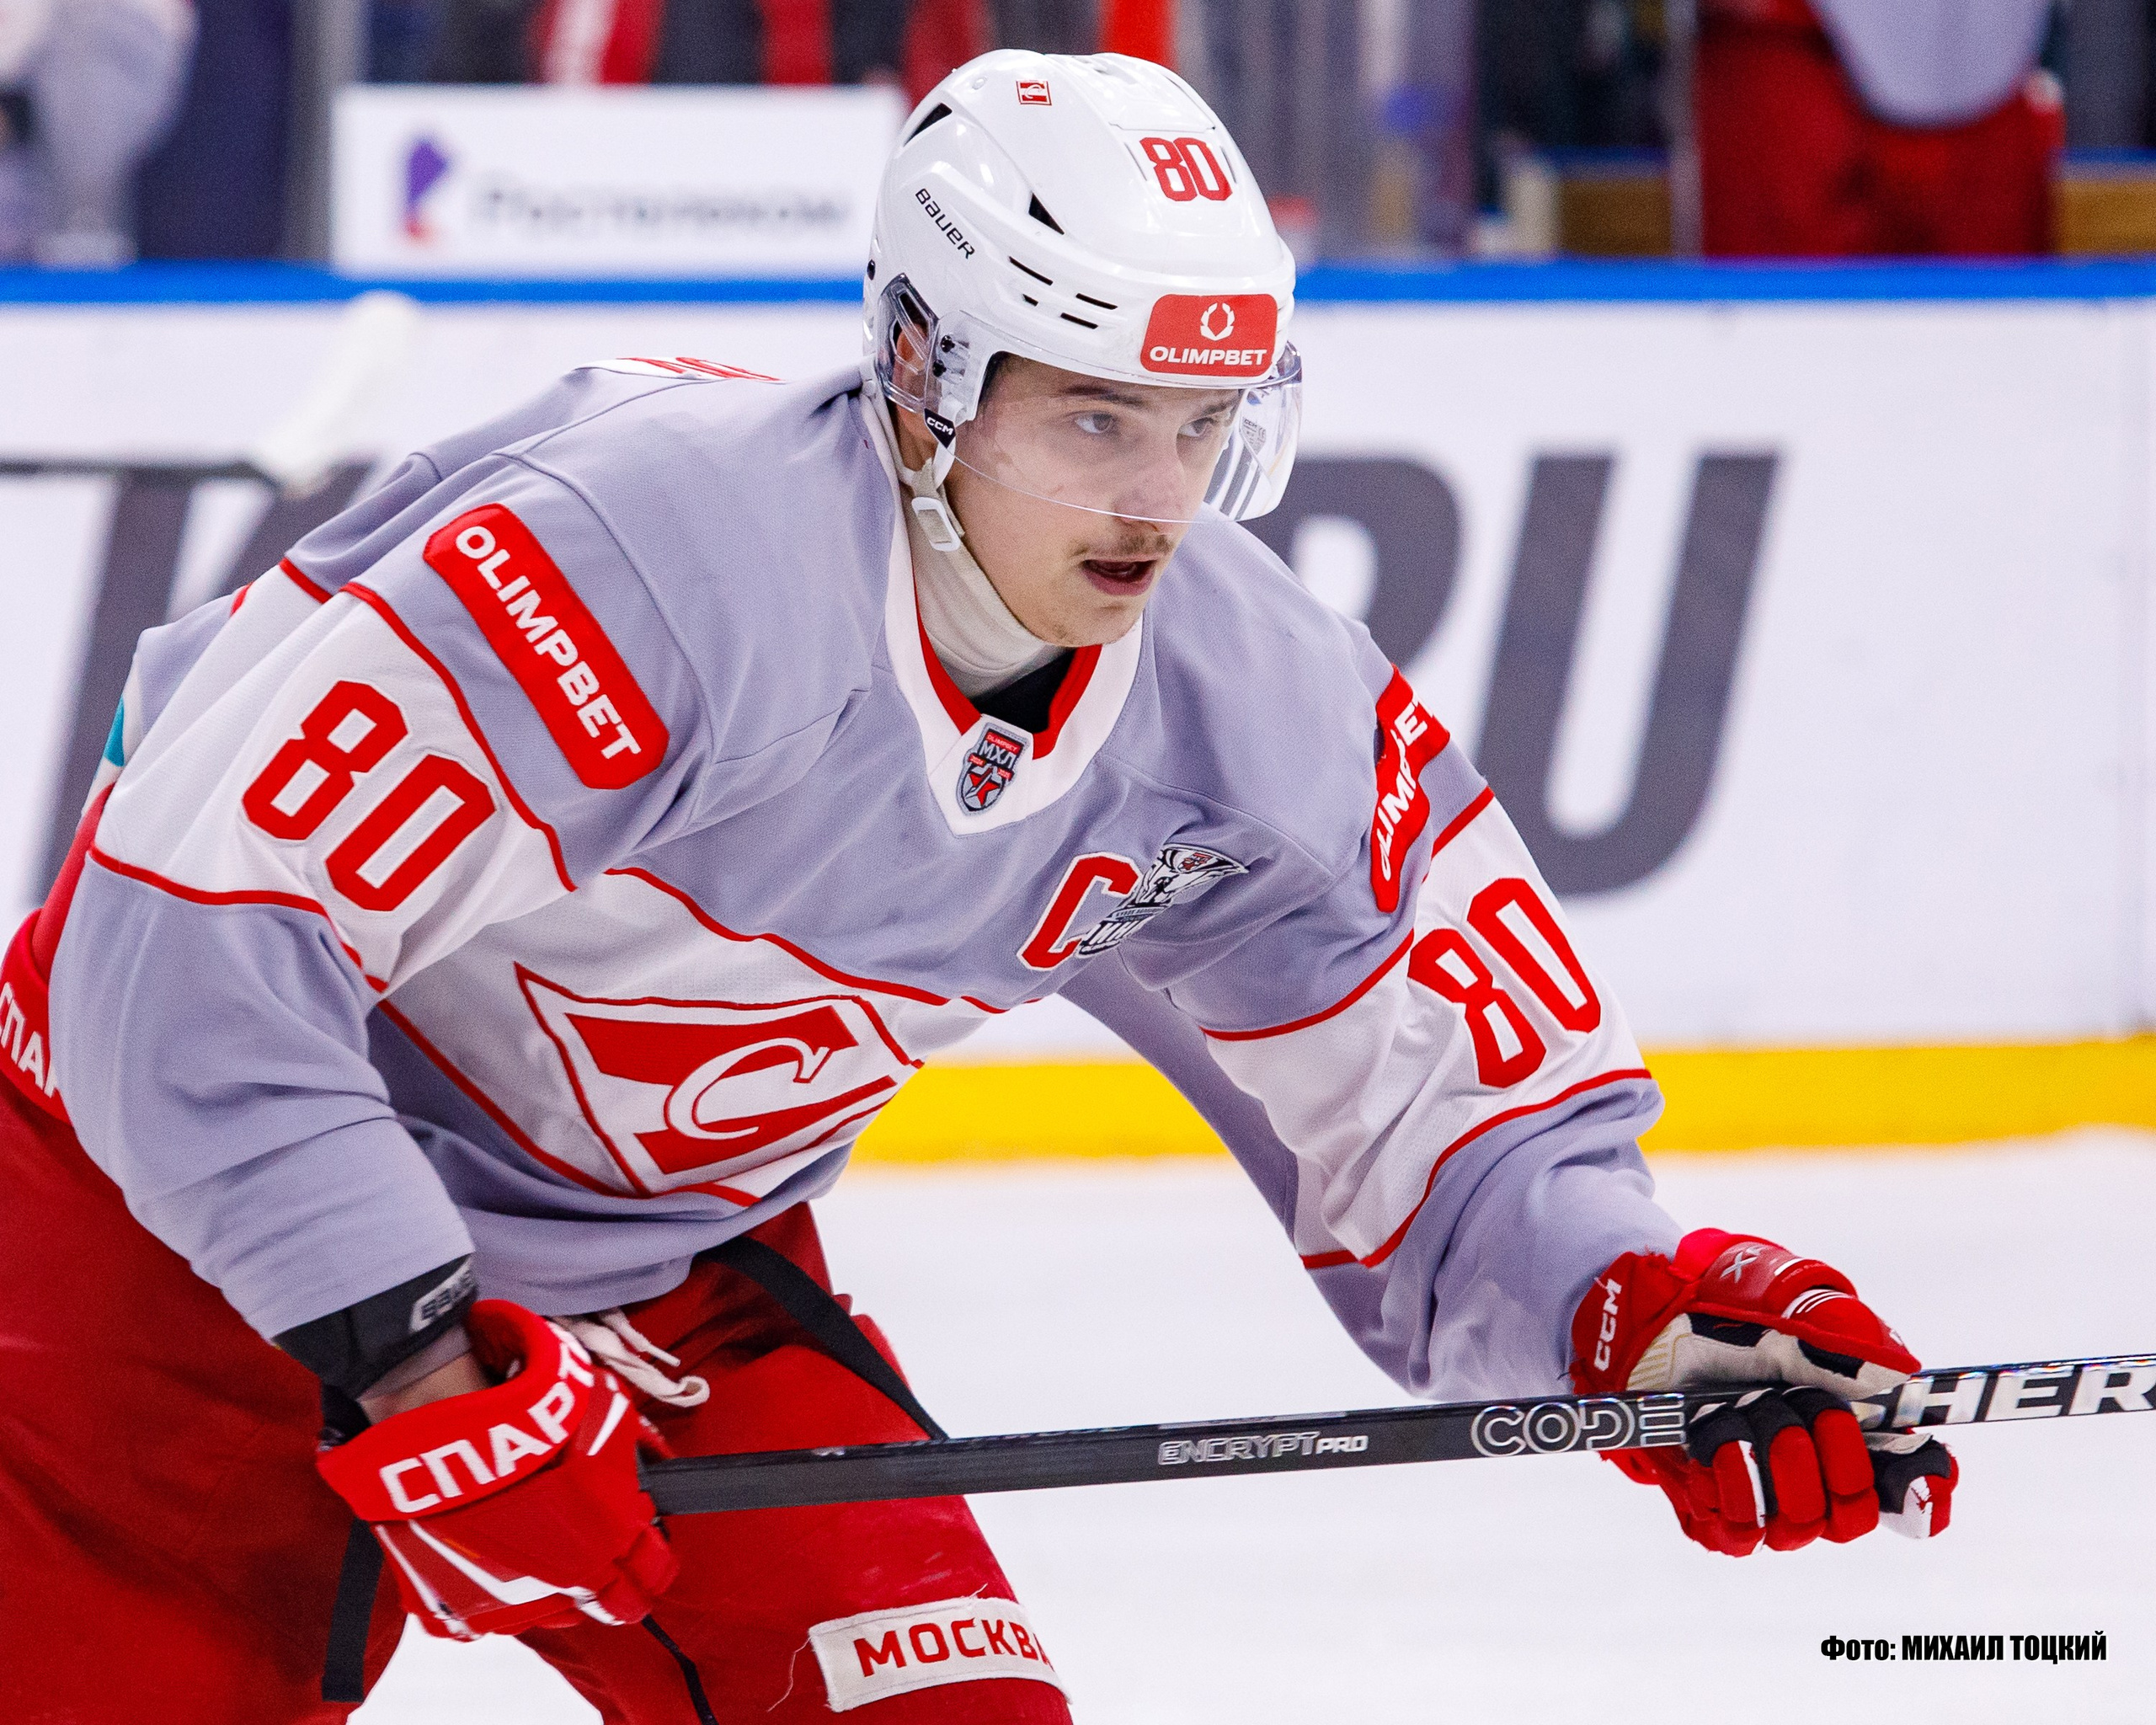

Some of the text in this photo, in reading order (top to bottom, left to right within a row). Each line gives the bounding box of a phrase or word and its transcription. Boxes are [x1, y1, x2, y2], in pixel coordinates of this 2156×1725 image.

[1139, 137, 1232, 201] 80
[915, 188, 975, 259] BAUER
[1150, 346, 1267, 366] OLIMPBET
[926, 417, 953, 435] CCM
[456, 526, 641, 759] OLIMPBET
[979, 740, 1017, 769] МХЛ
[242, 680, 497, 912] 80
[1407, 878, 1600, 1088] 80
[1593, 1278, 1622, 1371] CCM
